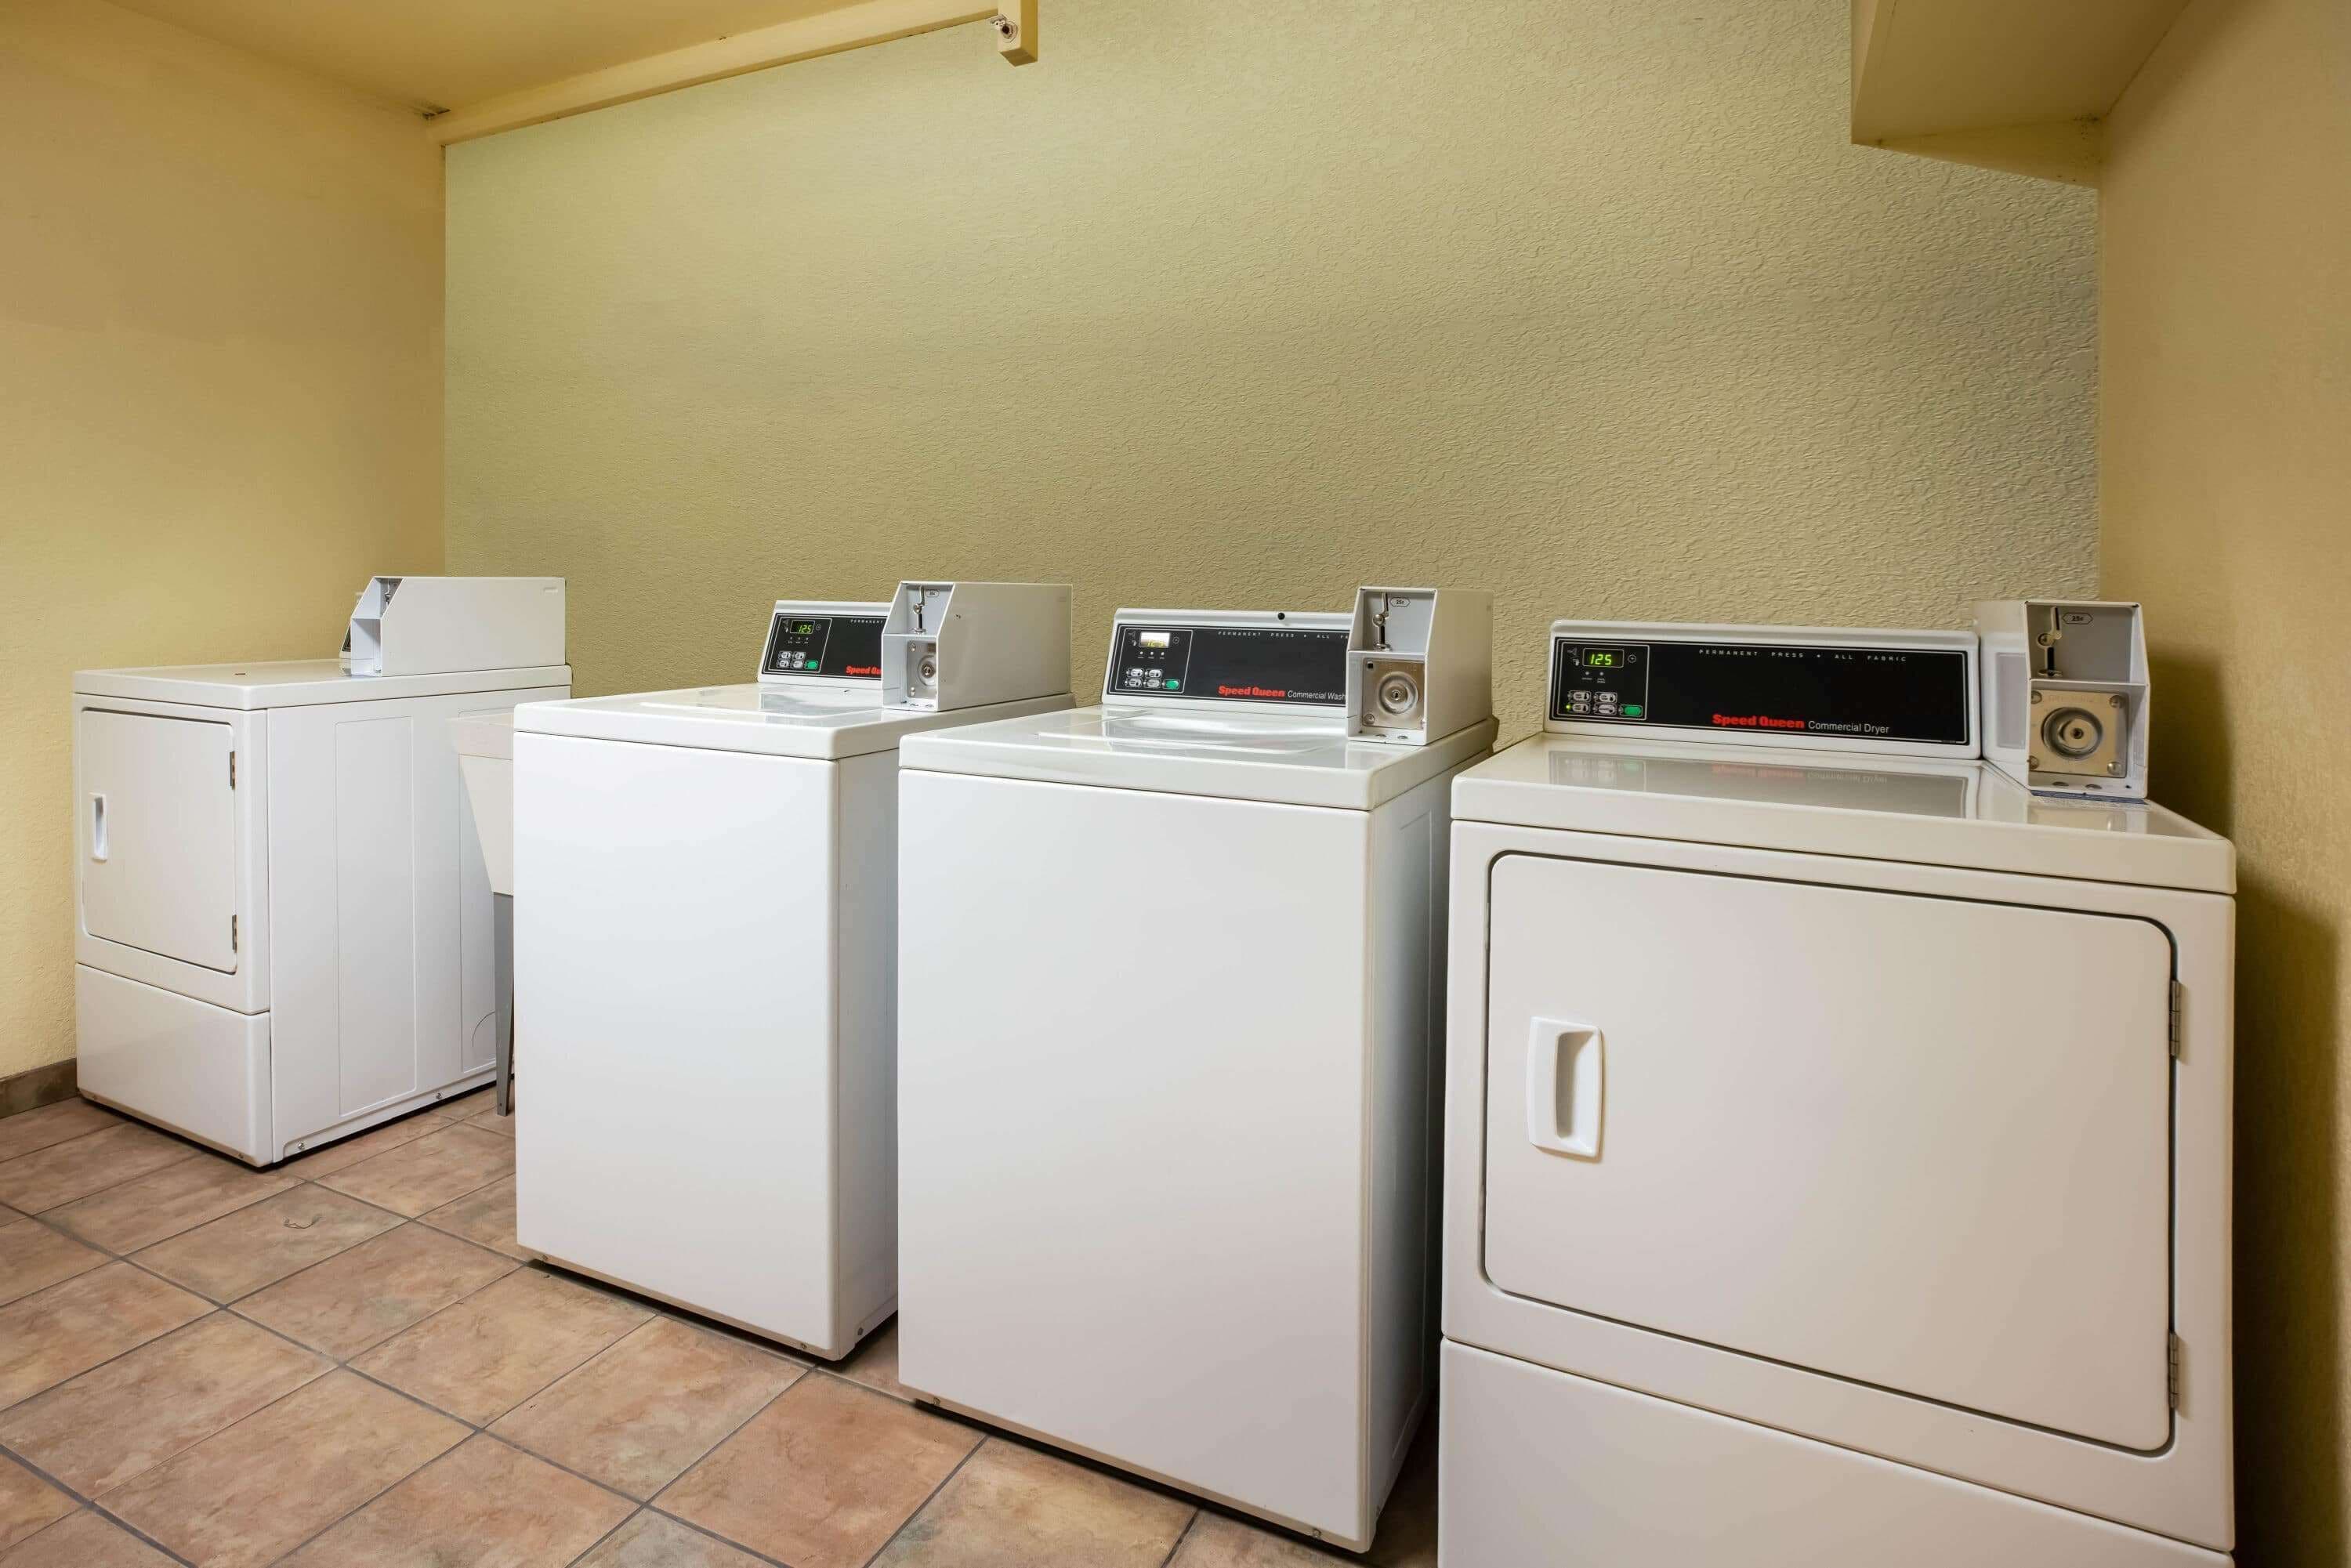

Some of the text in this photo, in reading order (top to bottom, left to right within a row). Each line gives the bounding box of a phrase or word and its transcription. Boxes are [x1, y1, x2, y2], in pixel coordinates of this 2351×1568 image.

[799, 625, 813, 634] 125
[1590, 654, 1612, 665] 125
[846, 665, 871, 675] Speed
[1219, 685, 1251, 697] Speed
[1252, 686, 1286, 697] Queen
[1288, 690, 1327, 700] Commercial
[1712, 714, 1890, 735] Speed Queen Commercial Dryer
